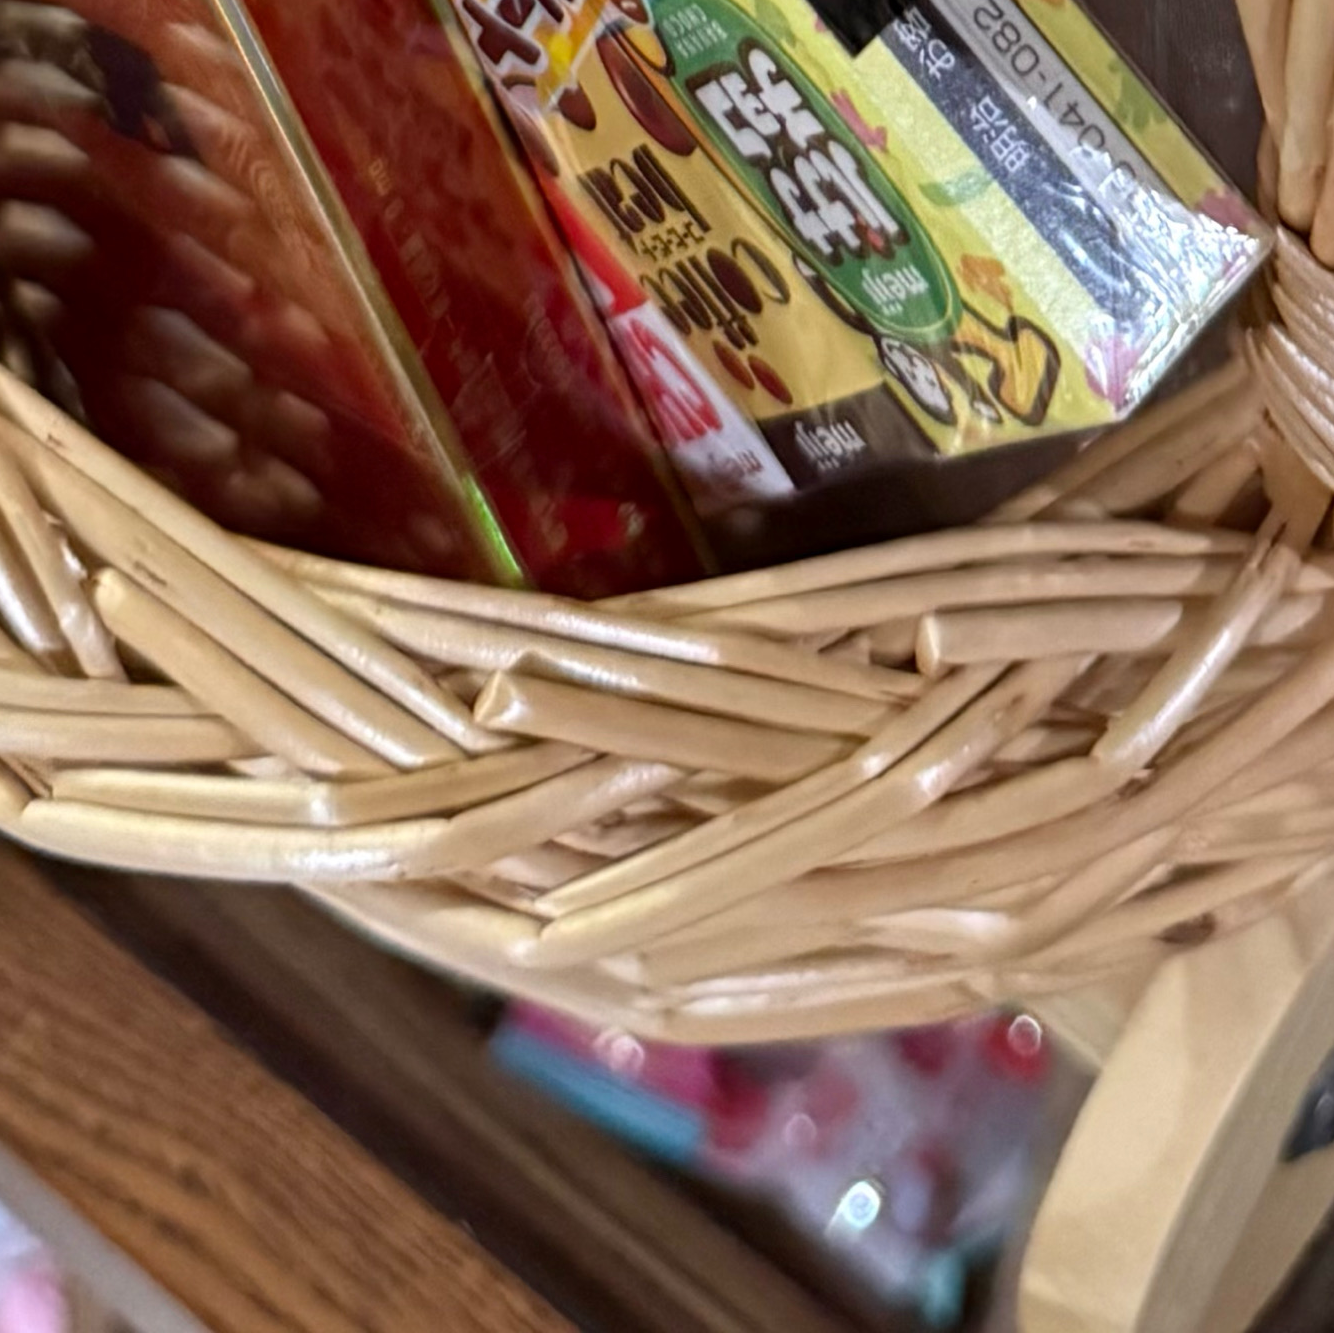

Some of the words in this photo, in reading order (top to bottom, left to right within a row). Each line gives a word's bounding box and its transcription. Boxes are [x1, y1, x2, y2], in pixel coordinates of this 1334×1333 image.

[661, 1, 708, 40] CHOCO
[674, 18, 728, 60] BANANA
[693, 43, 829, 161] チョコ
[969, 94, 1033, 174] 明治
[578, 144, 711, 249] beat
[769, 139, 901, 258] バナナ
[638, 235, 792, 351] coffee
[861, 263, 931, 316] meiji
[793, 419, 868, 471] meiji
